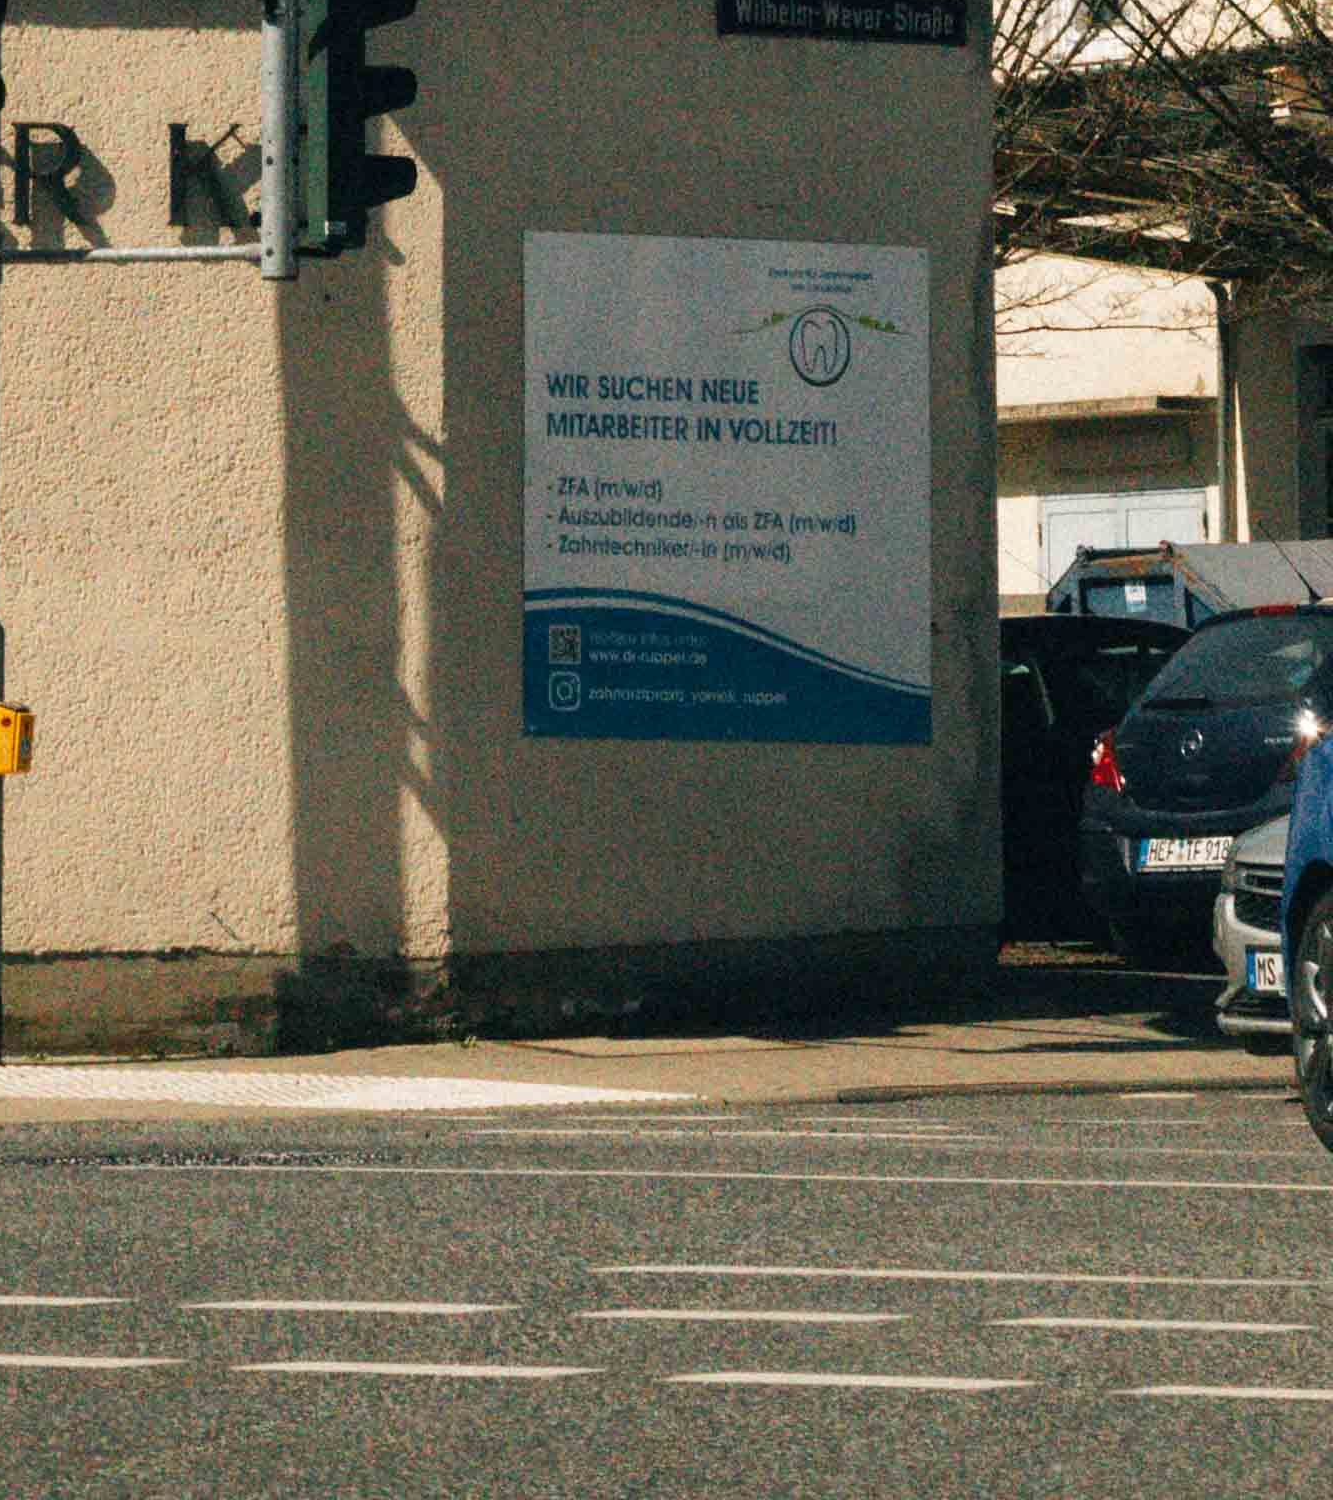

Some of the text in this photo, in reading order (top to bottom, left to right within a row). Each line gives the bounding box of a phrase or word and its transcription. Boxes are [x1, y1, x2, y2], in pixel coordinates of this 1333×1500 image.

[546, 373, 760, 405] WIR SUCHEN NEUE
[546, 413, 837, 446] MITARBEITER IN VOLLZEIT!
[557, 476, 590, 496] ZFA
[752, 512, 784, 531] ZFA
[1256, 957, 1277, 987] MS
